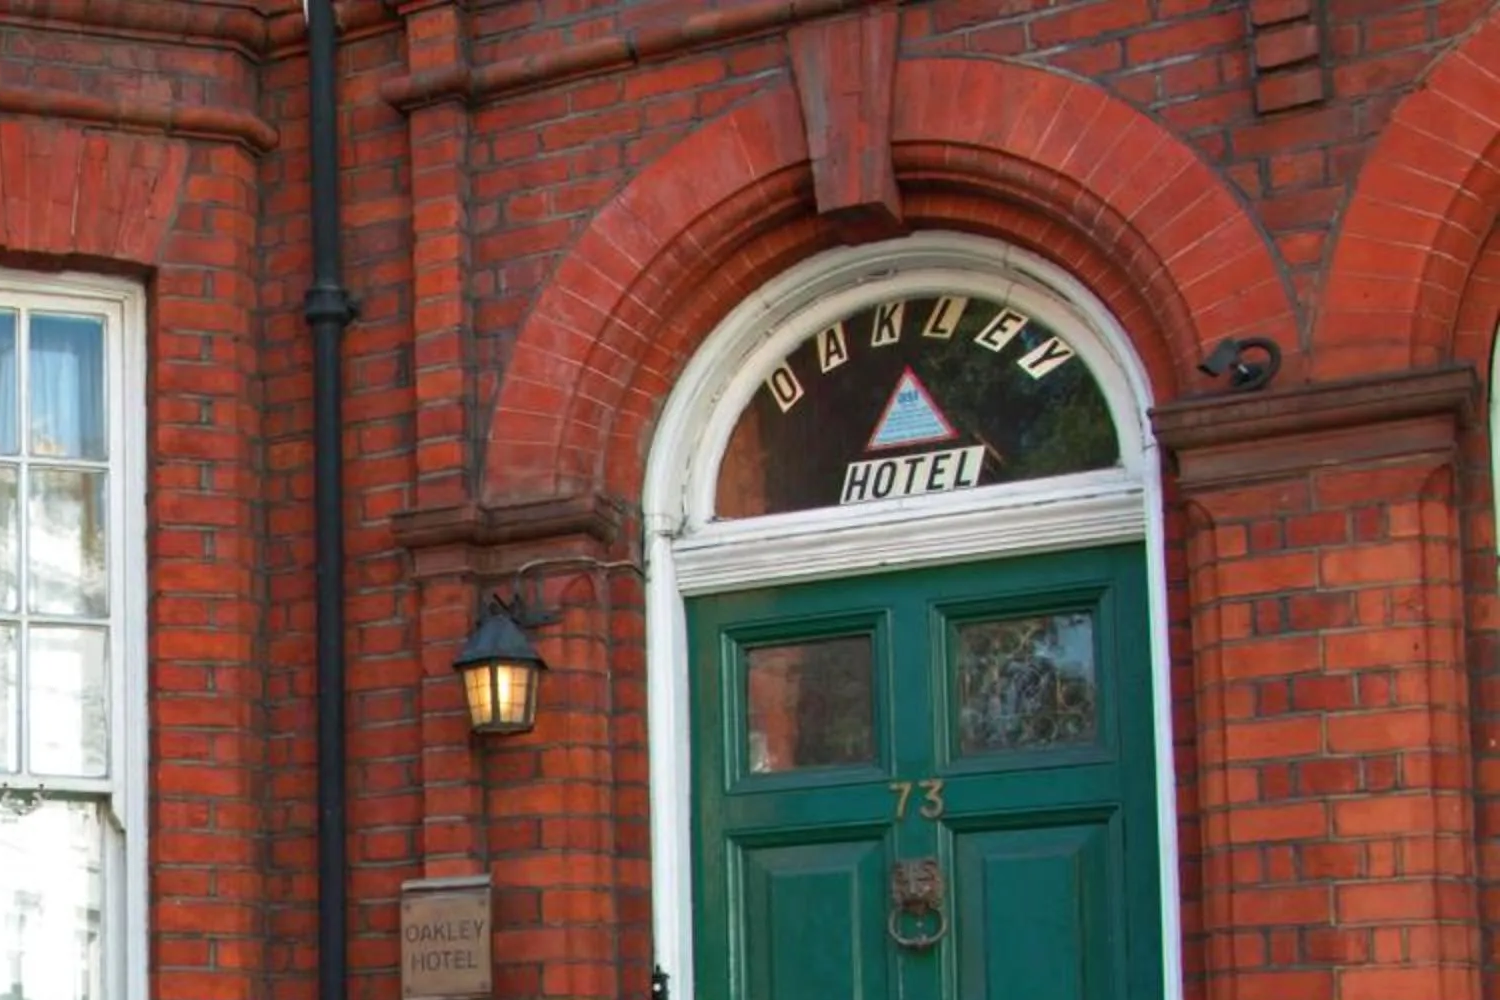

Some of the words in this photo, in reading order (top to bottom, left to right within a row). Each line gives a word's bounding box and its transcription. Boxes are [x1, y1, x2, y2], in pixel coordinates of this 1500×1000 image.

[771, 299, 1070, 401] OAKLEY
[845, 450, 974, 501] HOTEL
[889, 780, 943, 818] 73
[405, 920, 485, 943] OAKLEY
[411, 952, 477, 972] HOTEL
